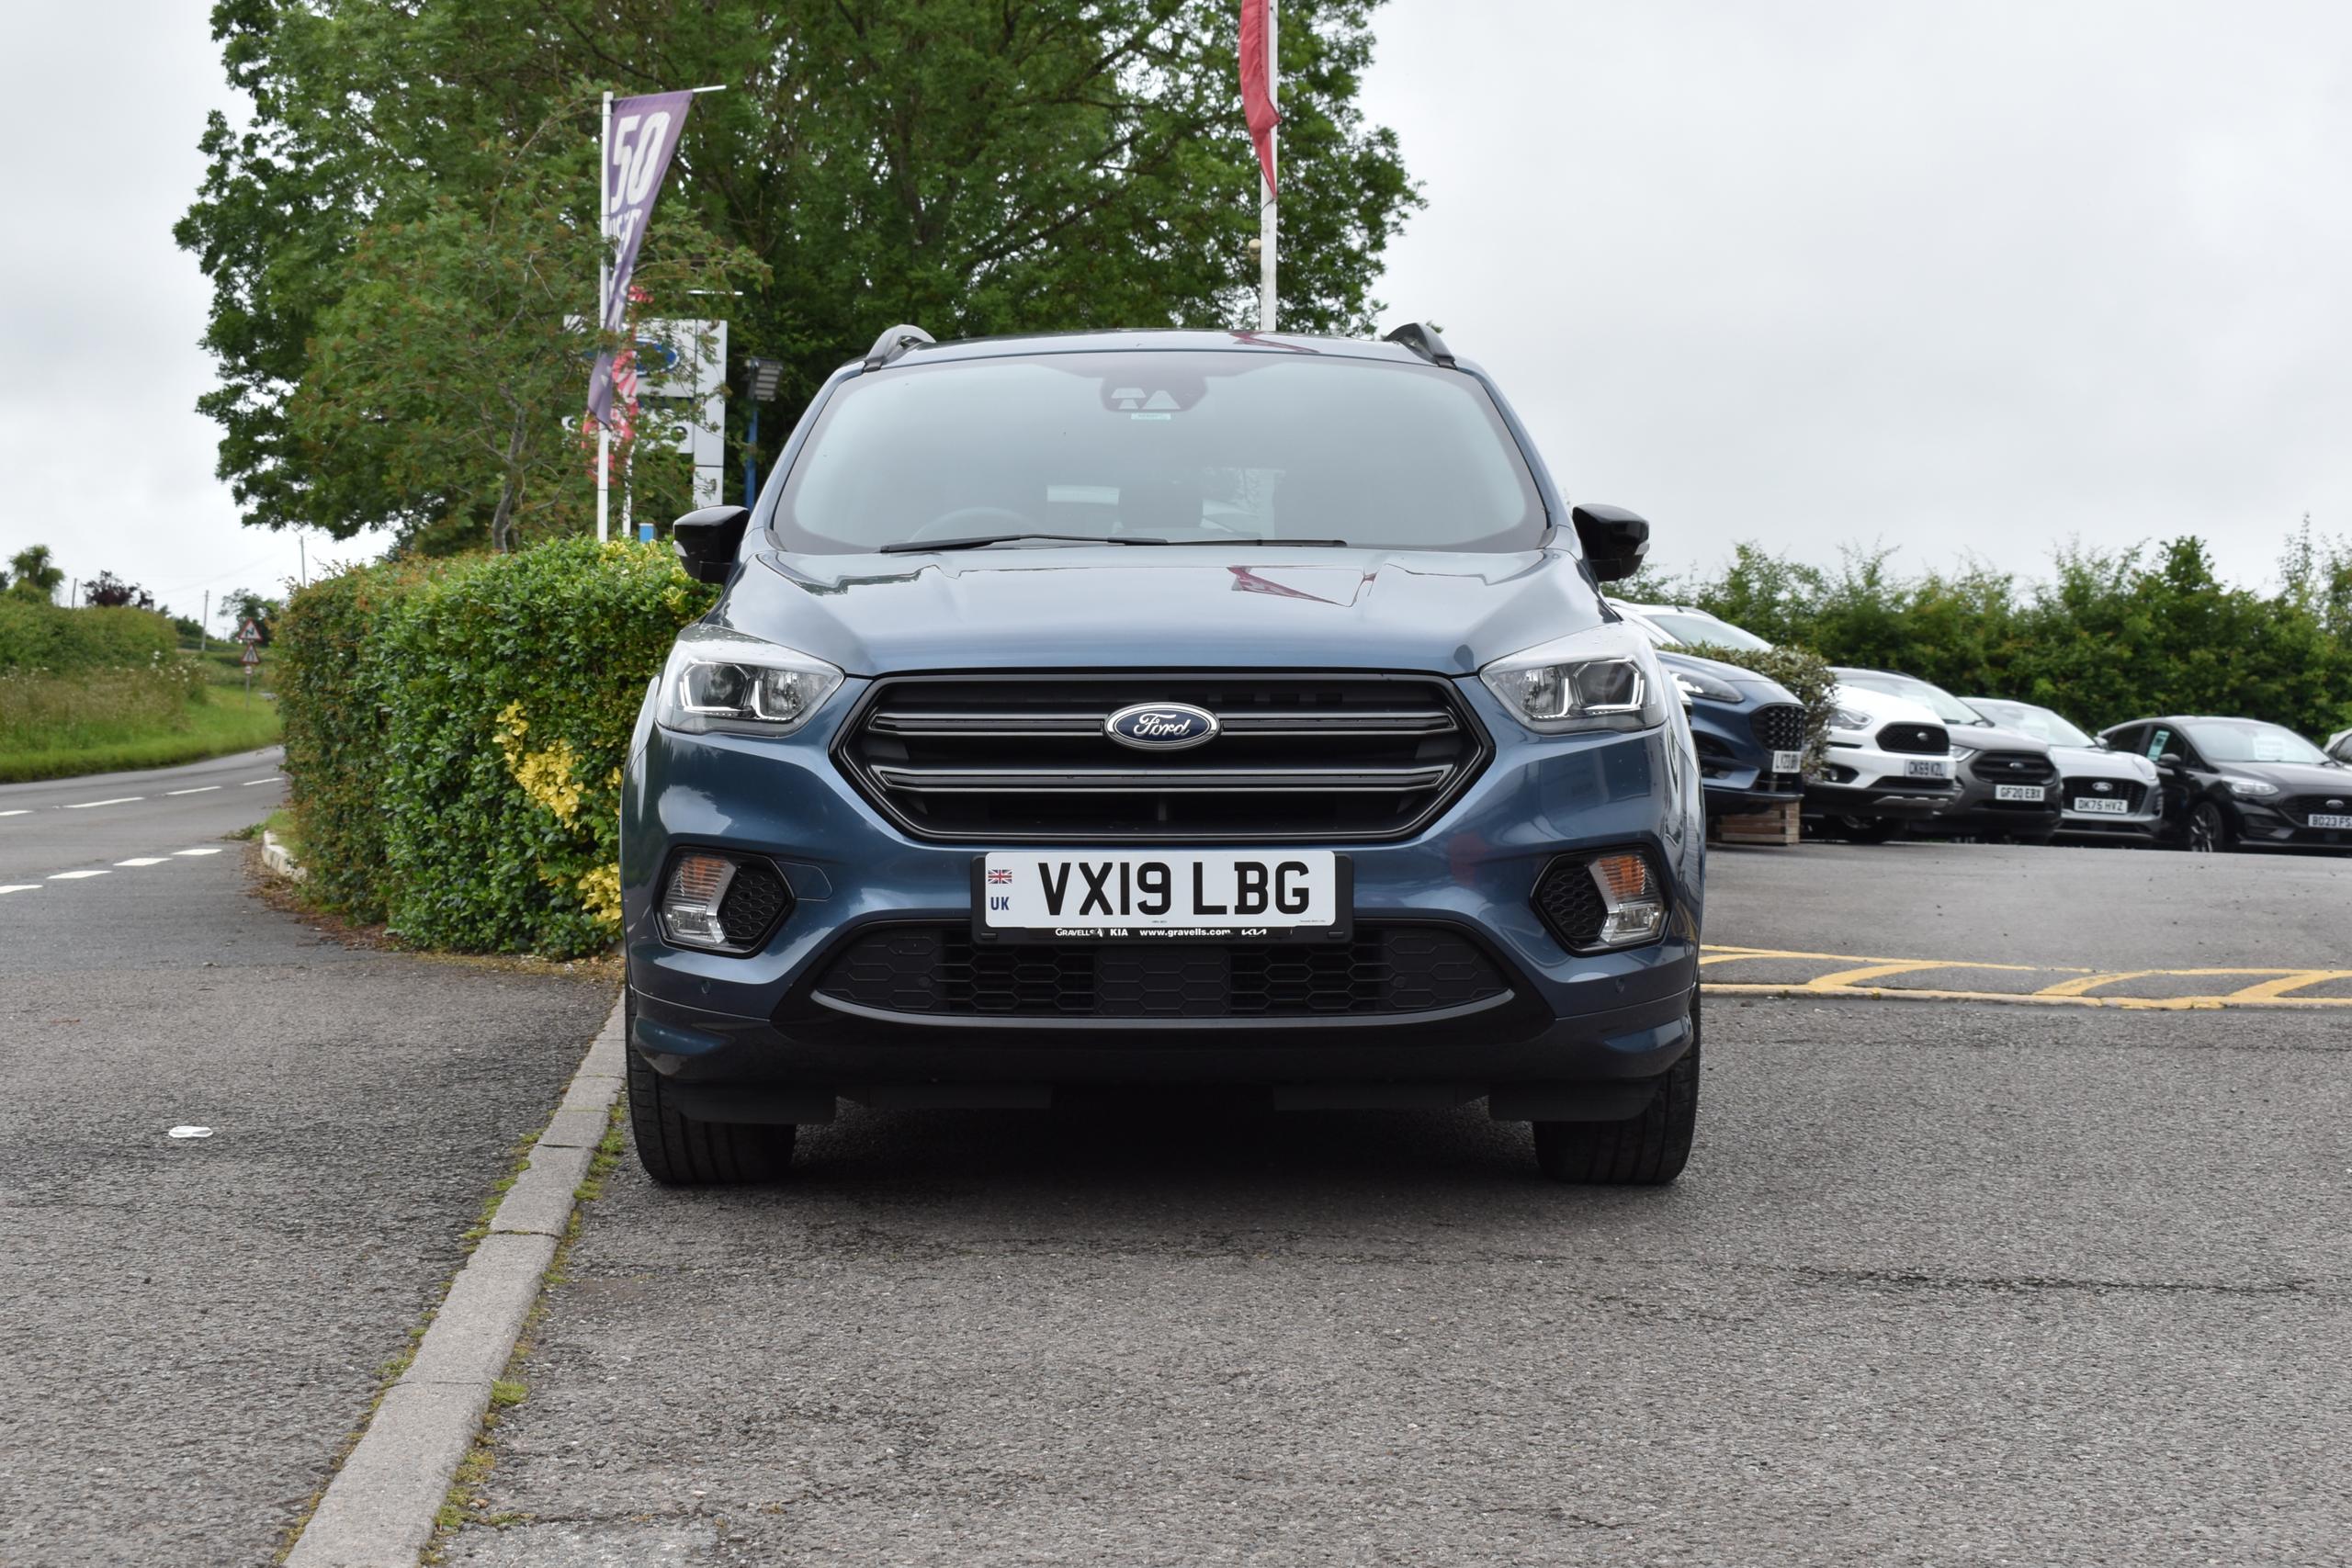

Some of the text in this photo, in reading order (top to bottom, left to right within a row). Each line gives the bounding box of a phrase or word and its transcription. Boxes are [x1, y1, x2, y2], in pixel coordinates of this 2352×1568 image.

[610, 111, 672, 214] 50
[1133, 713, 1192, 737] Ford
[1038, 861, 1310, 916] VX19 LBG
[990, 896, 1010, 911] UK
[1110, 928, 1128, 937] KIA
